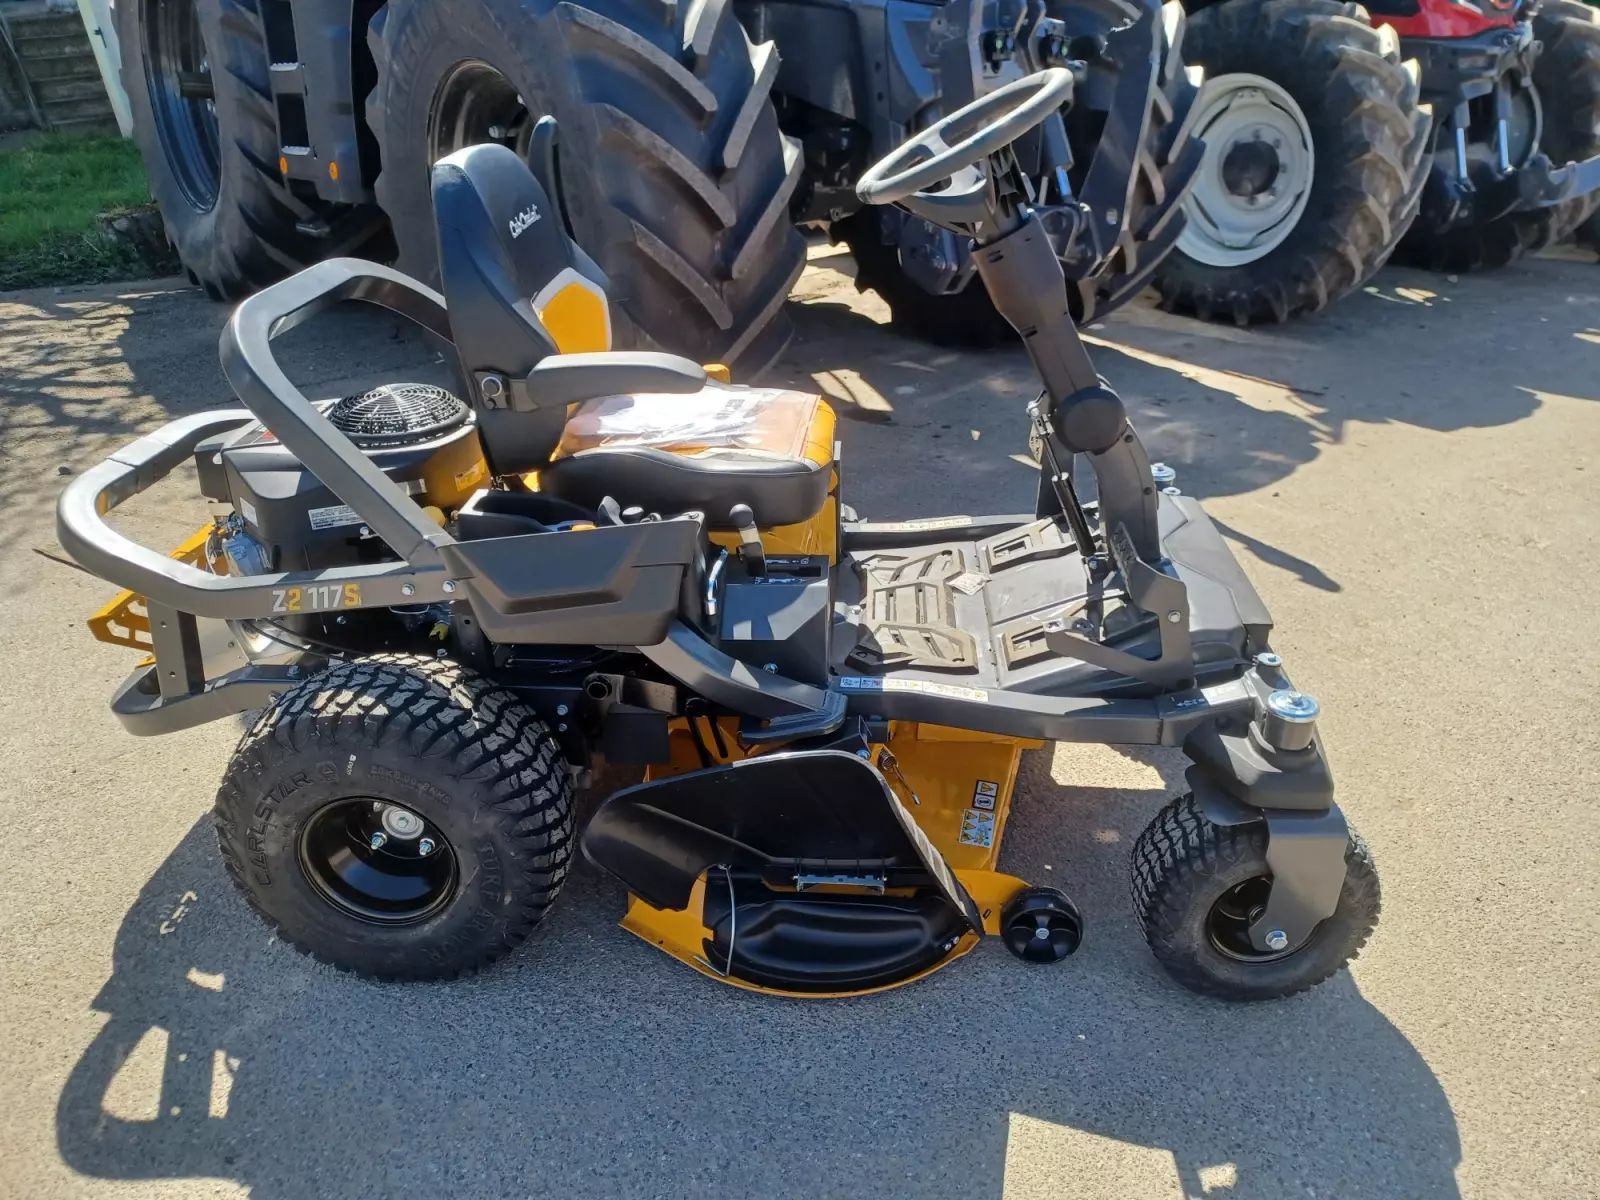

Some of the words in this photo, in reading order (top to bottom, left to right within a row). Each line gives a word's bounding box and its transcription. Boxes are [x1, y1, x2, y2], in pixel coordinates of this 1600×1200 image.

[272, 587, 302, 612] Z2
[307, 583, 360, 609] 117S
[247, 770, 314, 887] CARLSTAR
